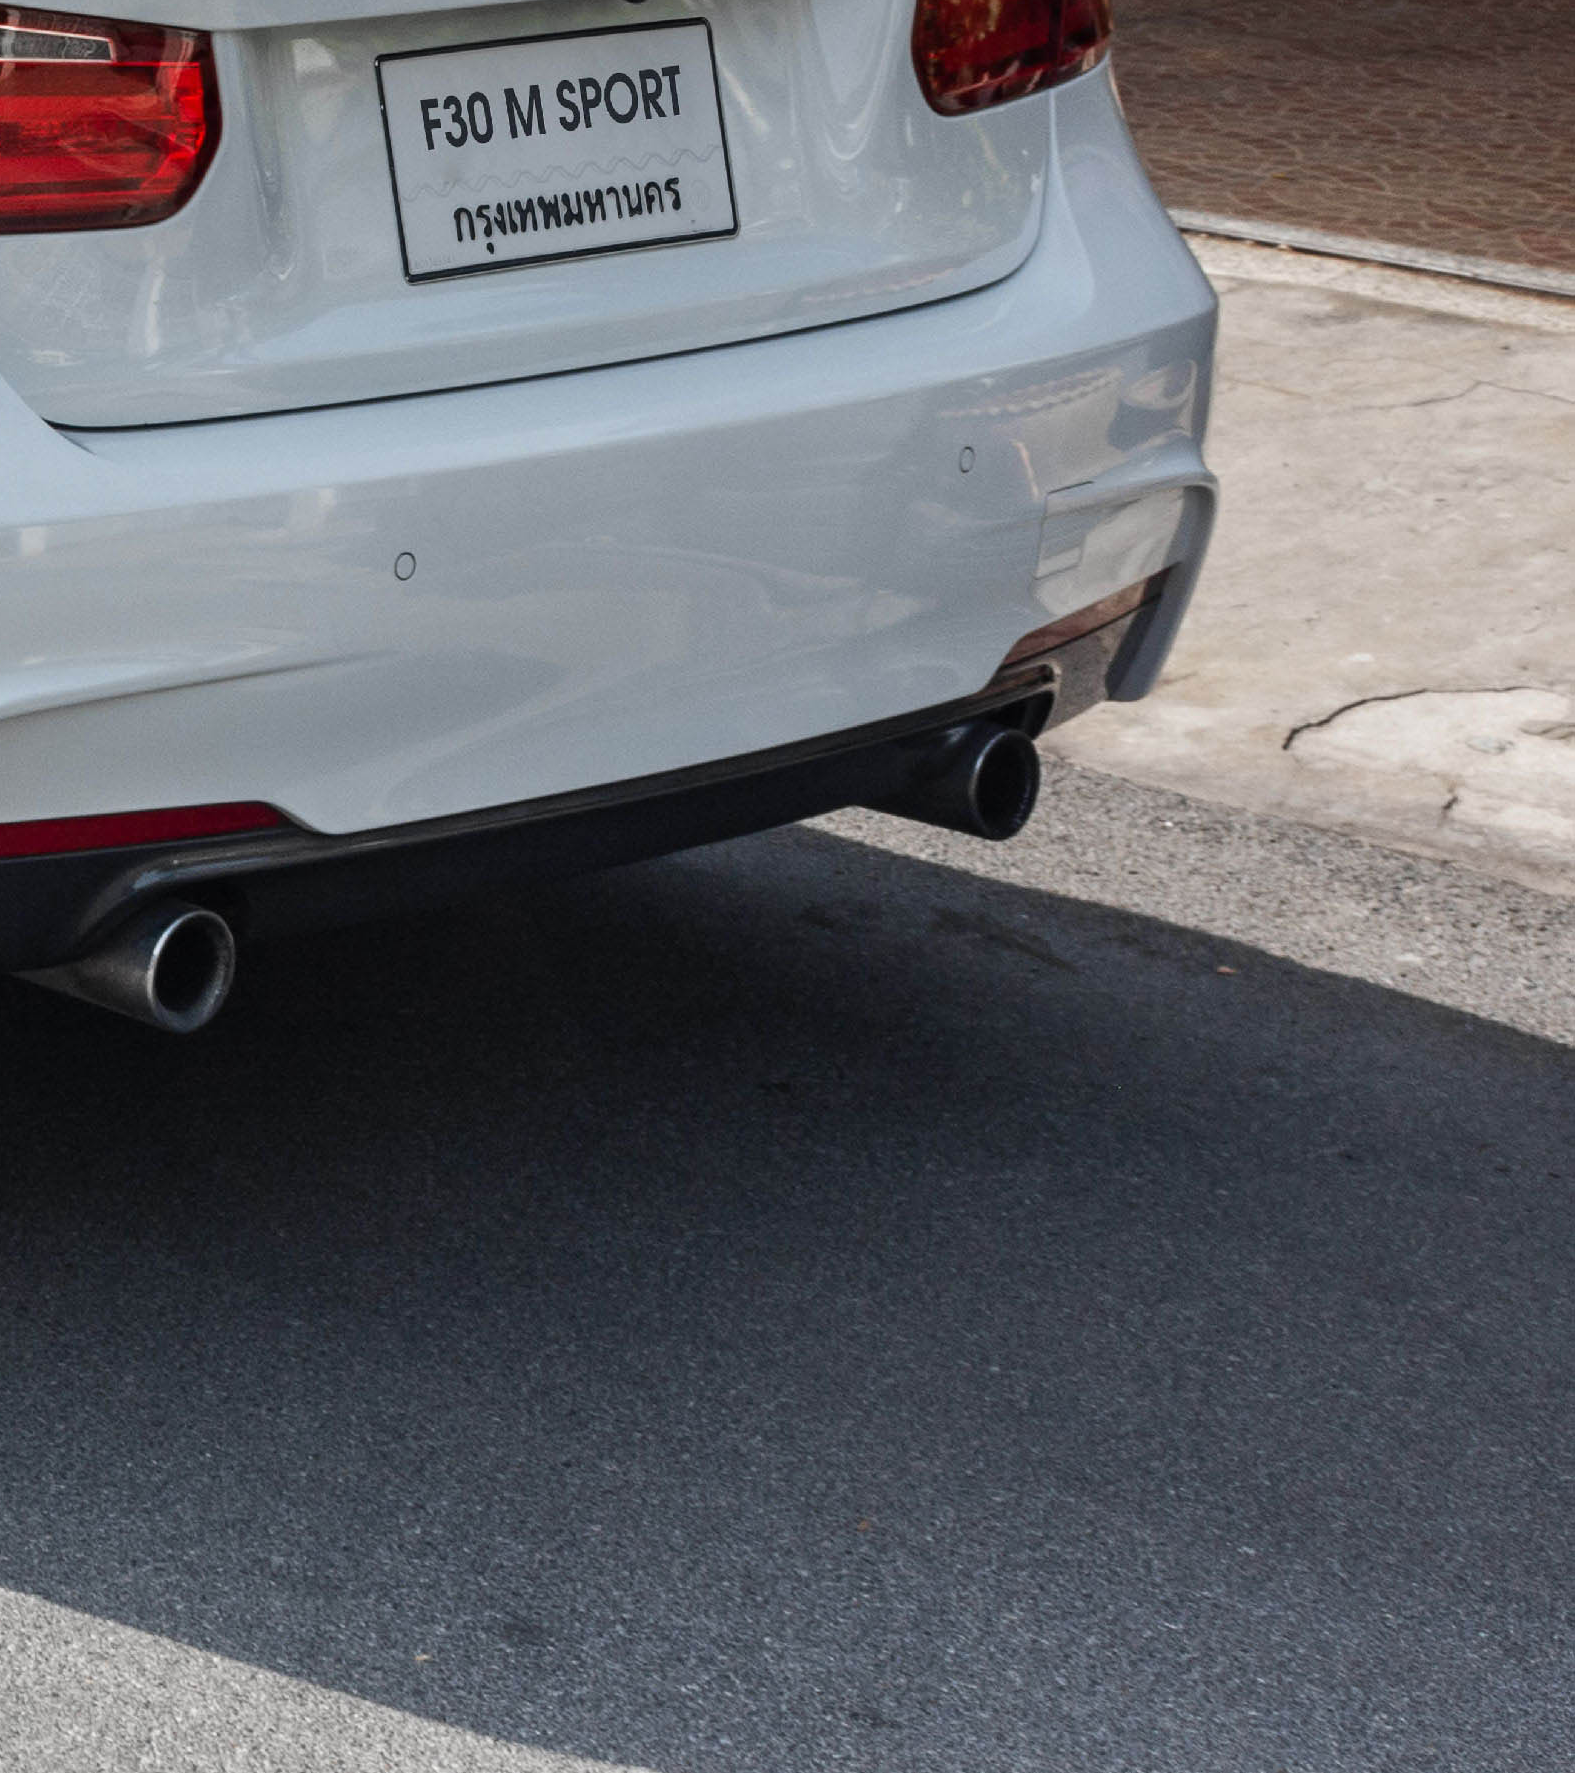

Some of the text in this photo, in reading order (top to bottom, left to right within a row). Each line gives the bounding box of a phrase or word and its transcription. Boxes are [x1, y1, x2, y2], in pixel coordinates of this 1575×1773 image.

[420, 65, 681, 151] F30 M SPORT
[453, 177, 682, 255] กรุงเทพมหานคร
